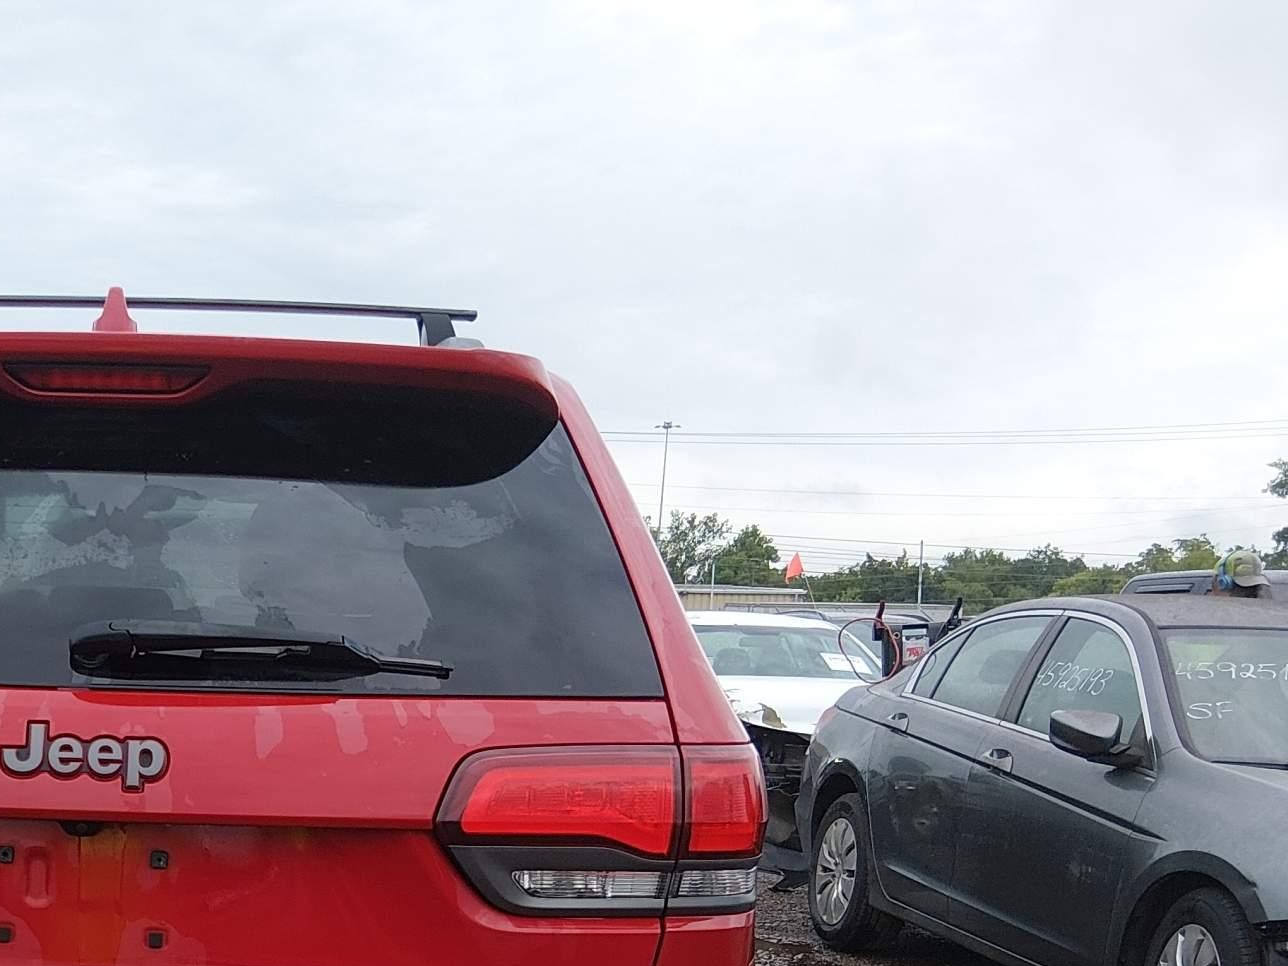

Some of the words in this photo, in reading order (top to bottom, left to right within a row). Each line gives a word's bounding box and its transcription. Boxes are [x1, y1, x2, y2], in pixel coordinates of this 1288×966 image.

[1036, 661, 1114, 696] 45925193
[1186, 701, 1233, 720] SF
[0, 721, 170, 792] Jeep
